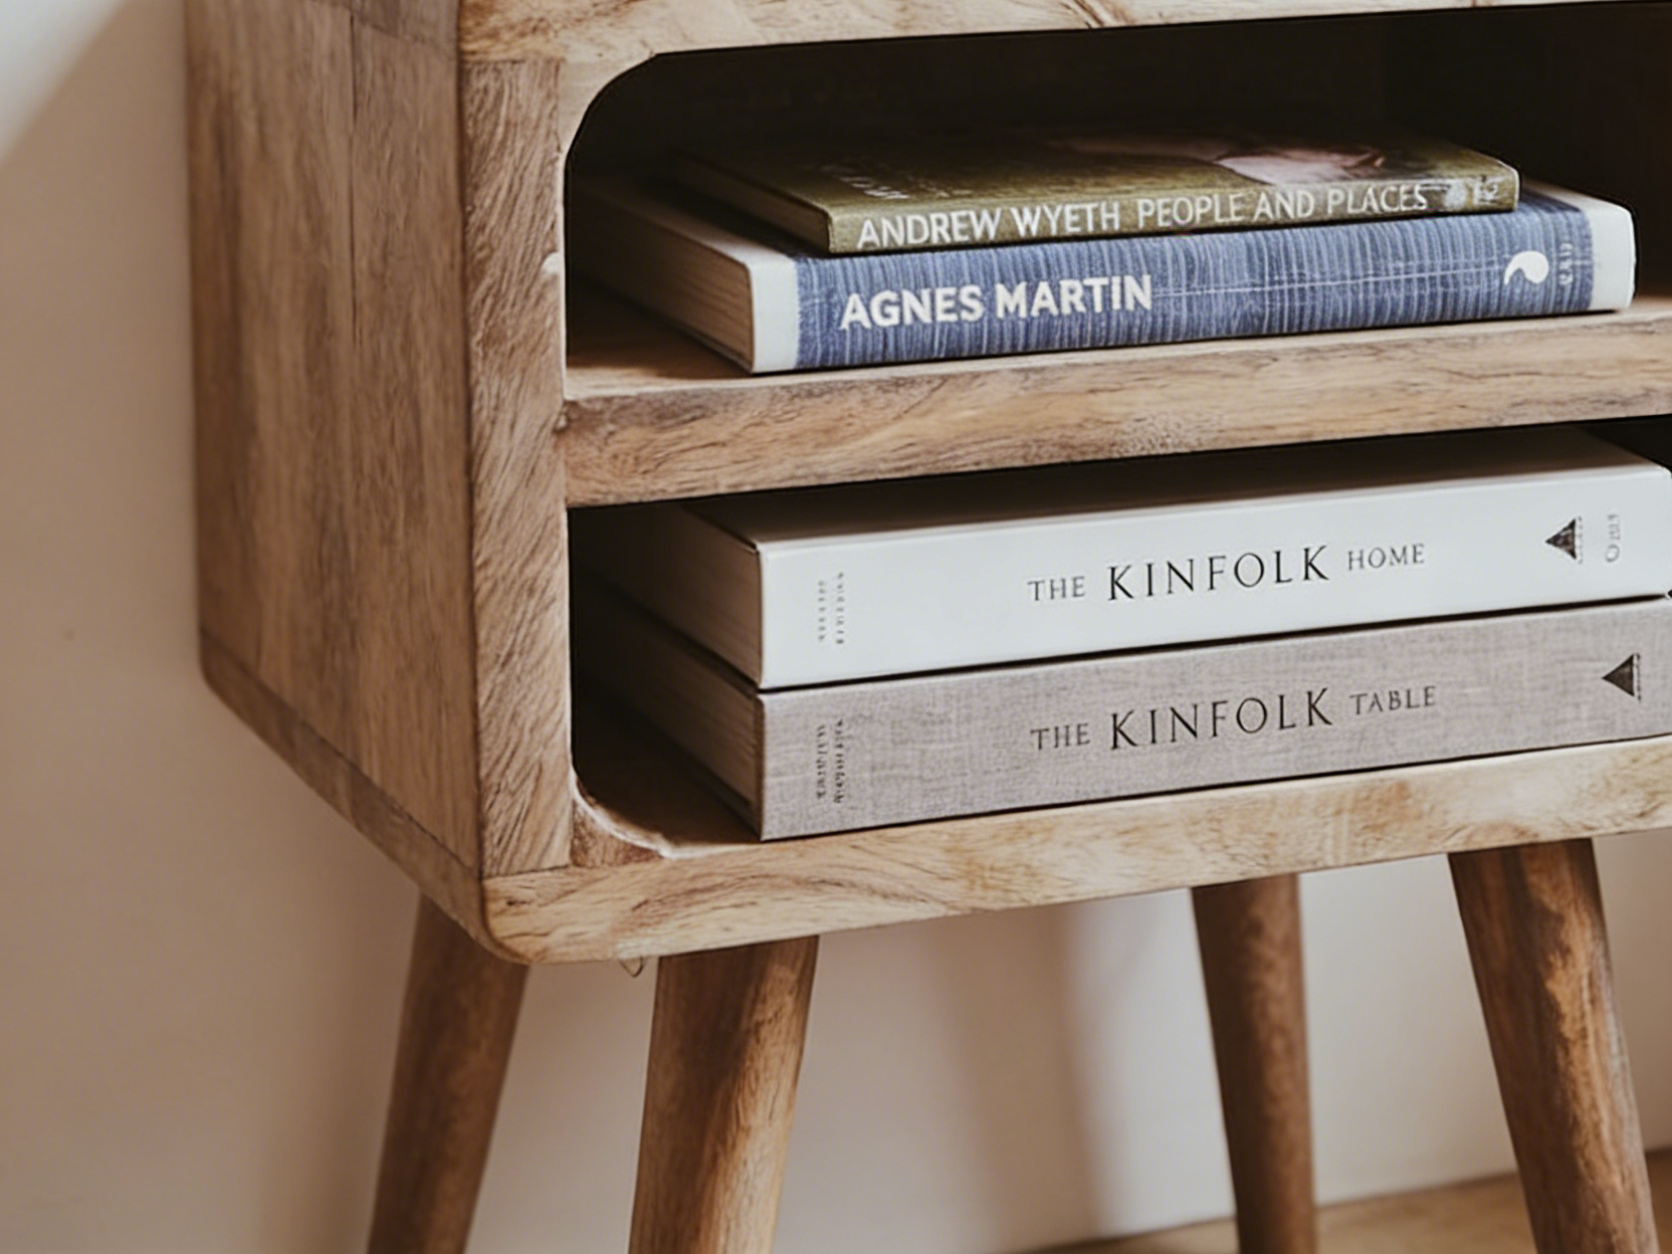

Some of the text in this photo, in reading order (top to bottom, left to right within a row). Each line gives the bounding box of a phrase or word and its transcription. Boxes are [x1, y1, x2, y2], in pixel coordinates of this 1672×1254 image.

[857, 208, 1001, 249] ANDREW
[1009, 201, 1121, 236] WYETH
[1137, 191, 1246, 229] PEOPLE
[1254, 188, 1314, 221] AND
[1327, 184, 1428, 216] PLACES
[840, 274, 1152, 330] AGNES MARTIN
[1027, 543, 1426, 602] THE KINFOLK HOME
[1030, 685, 1437, 751] THE KINFOLK TABLE
